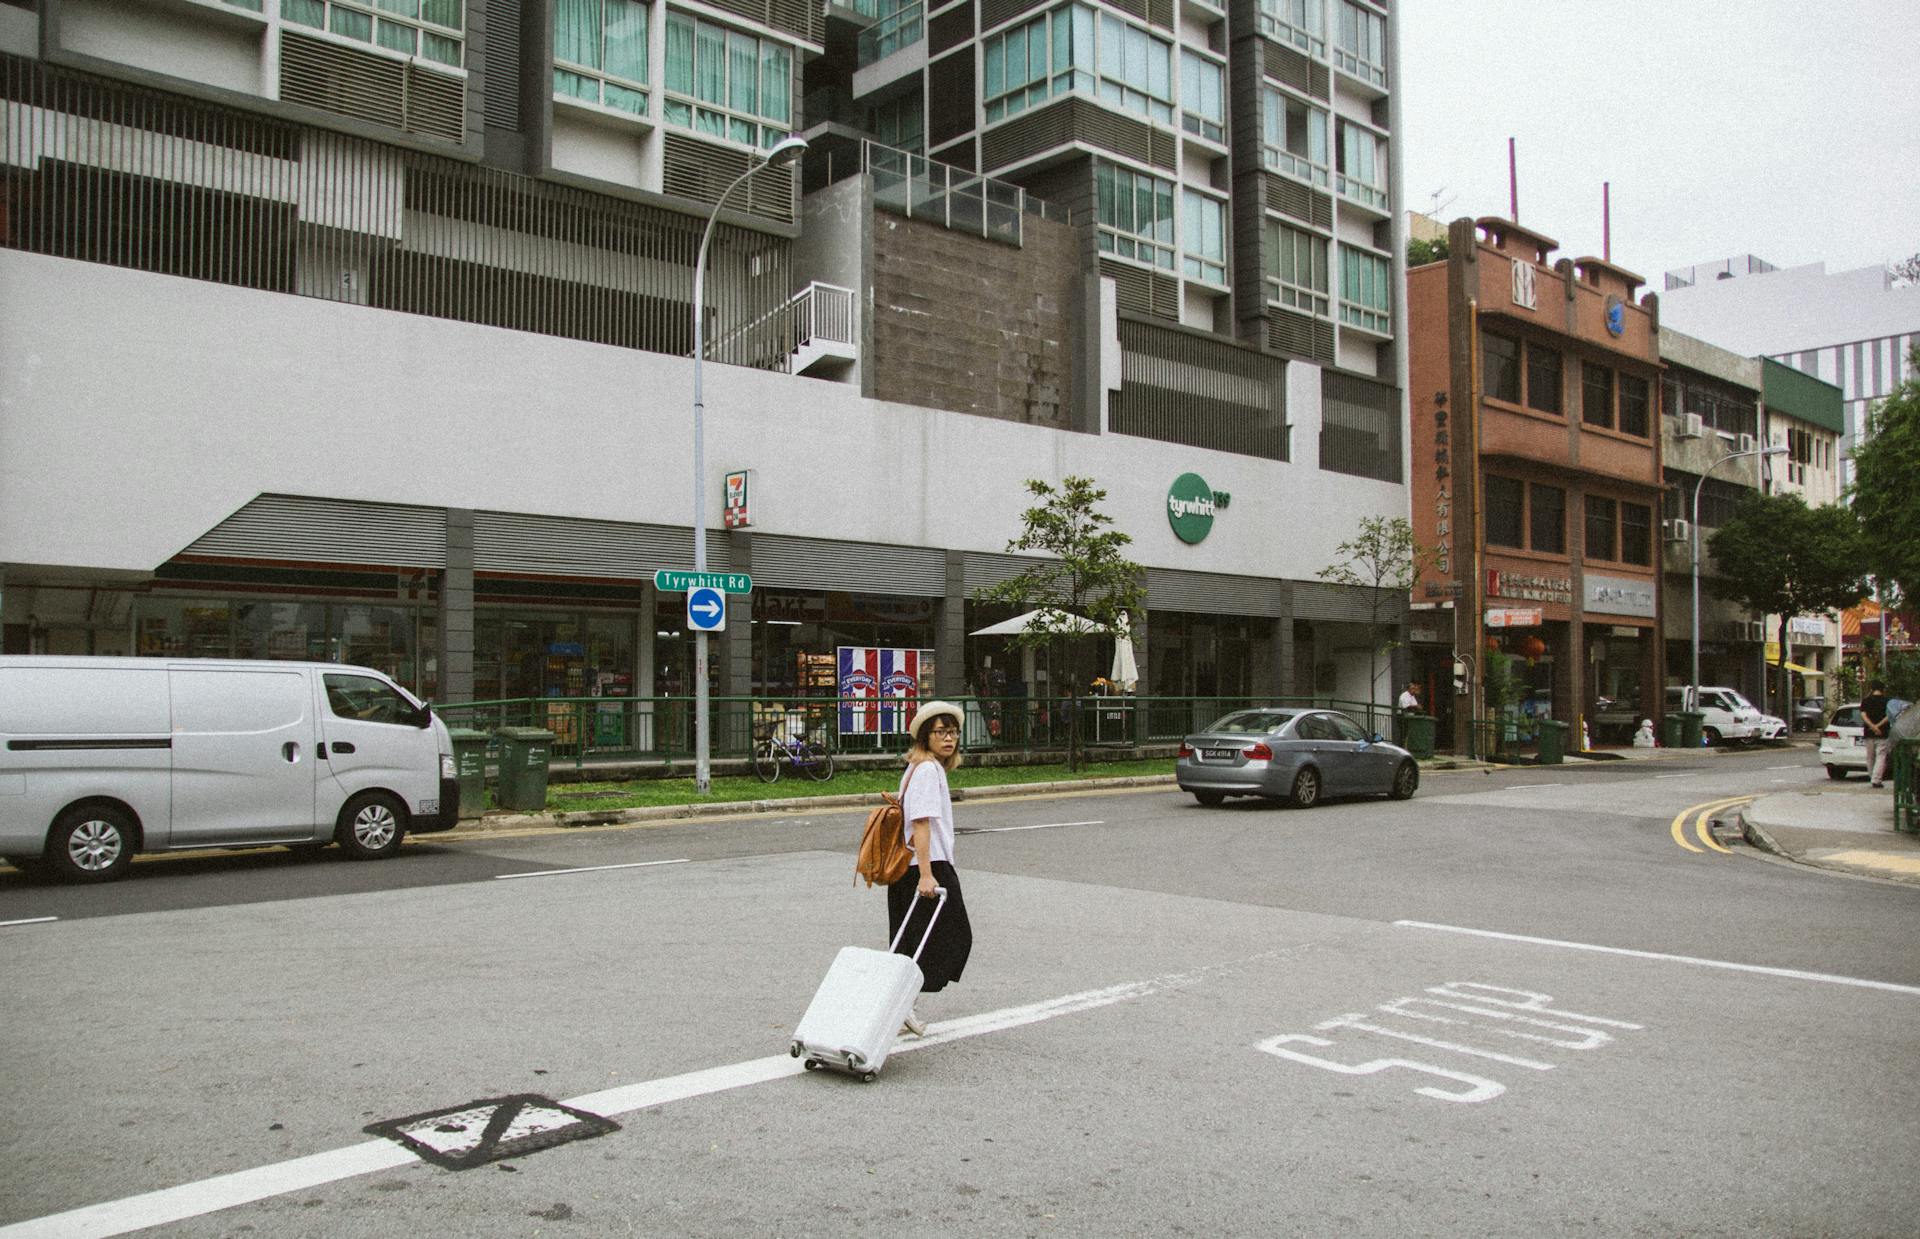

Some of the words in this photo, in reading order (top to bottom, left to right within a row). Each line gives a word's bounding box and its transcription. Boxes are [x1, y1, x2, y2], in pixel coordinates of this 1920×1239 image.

[1169, 496, 1215, 518] tyrwhitt
[664, 573, 724, 589] Tyrwhitt
[729, 576, 745, 589] Rd
[846, 675, 872, 684] EVERYDAY
[887, 677, 911, 686] EVERYDAY
[1254, 981, 1645, 1103] STOP
